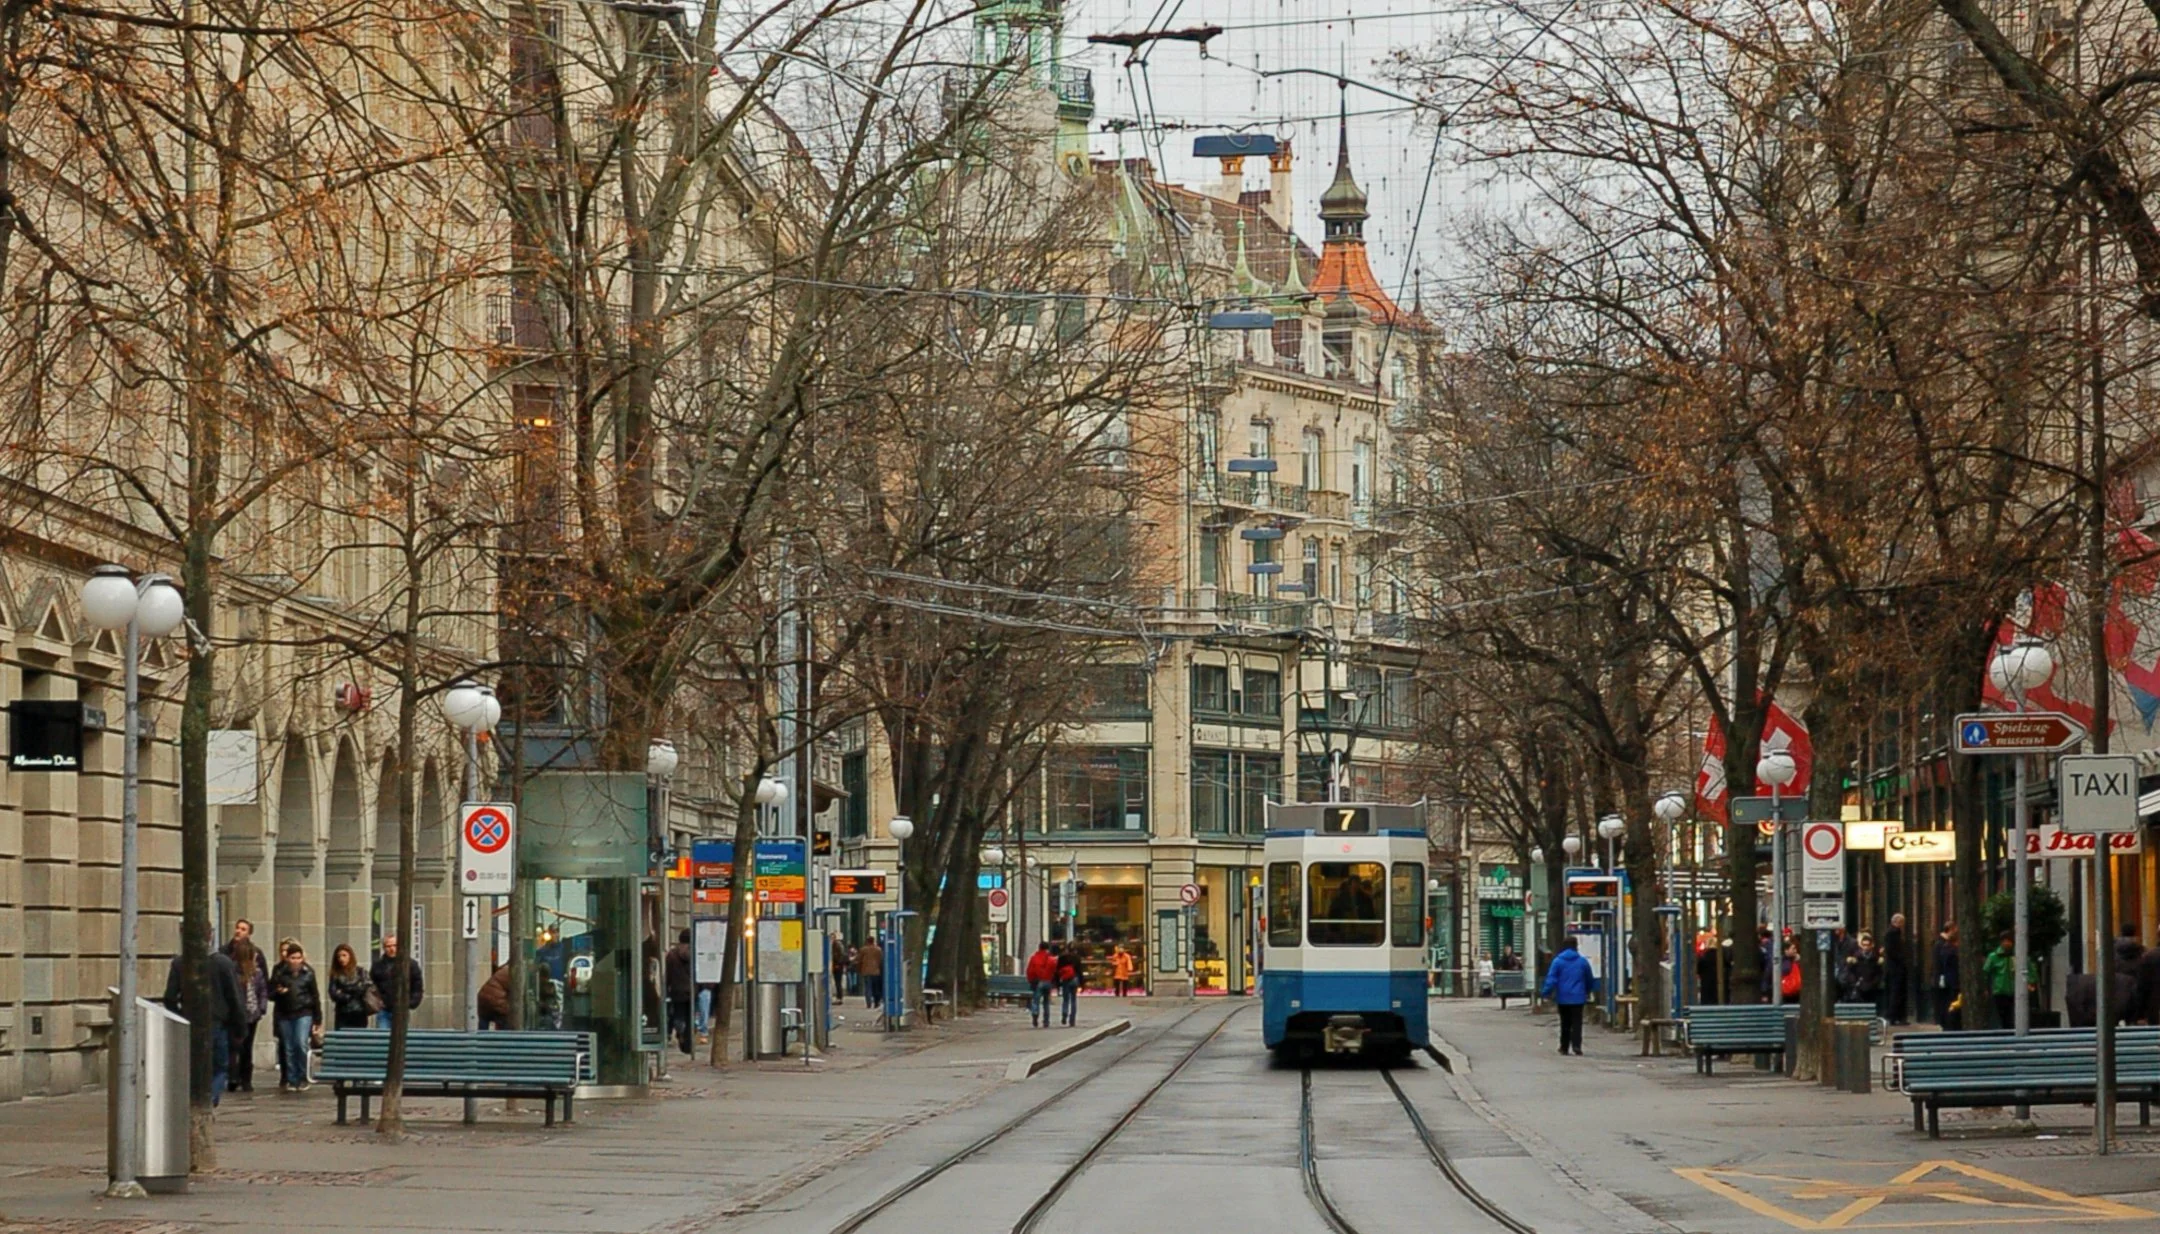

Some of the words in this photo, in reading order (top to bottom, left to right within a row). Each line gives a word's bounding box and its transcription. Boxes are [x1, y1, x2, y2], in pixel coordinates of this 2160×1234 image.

[2069, 773, 2129, 796] TAXI
[1338, 809, 1355, 831] 7
[2045, 830, 2138, 851] Baa
